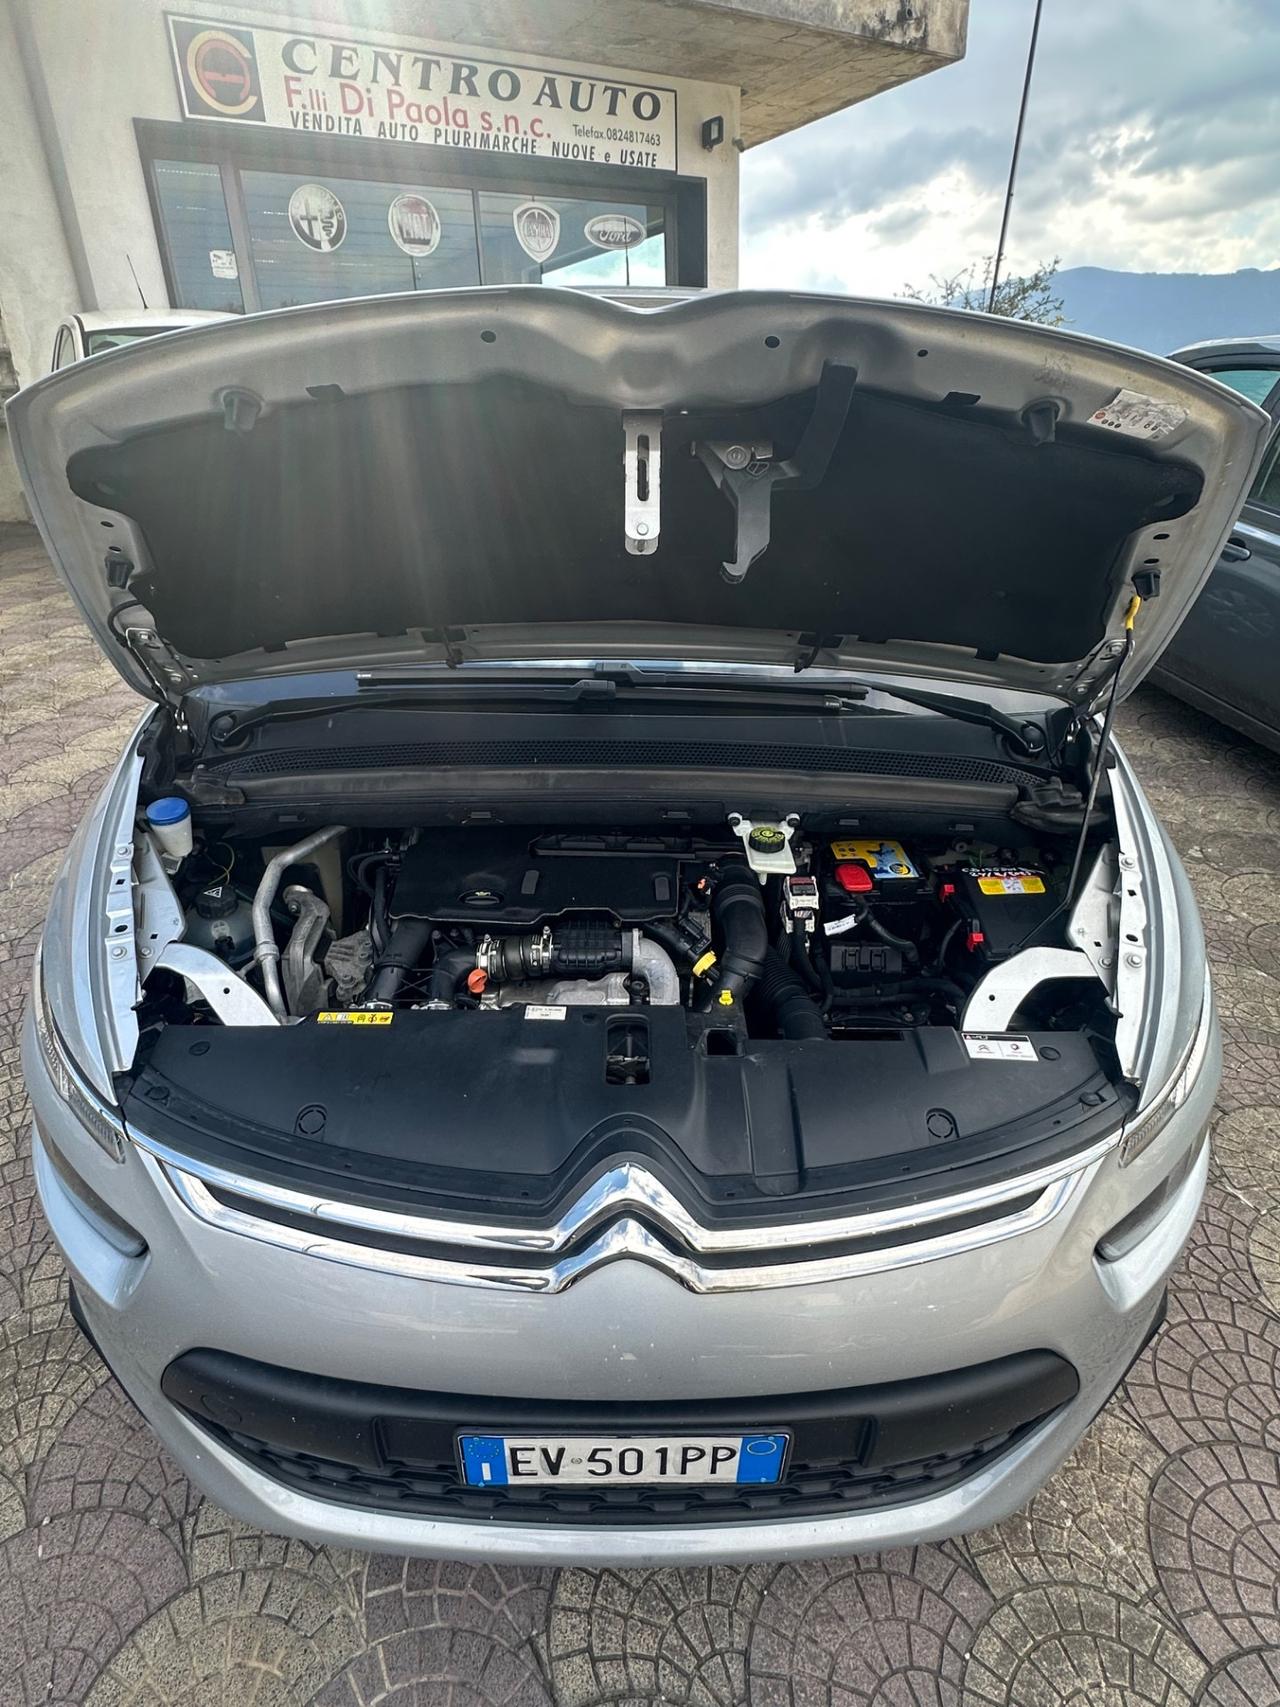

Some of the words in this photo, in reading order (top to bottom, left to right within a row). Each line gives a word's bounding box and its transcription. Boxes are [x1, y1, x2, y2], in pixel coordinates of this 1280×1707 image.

[281, 39, 521, 102] CENTRO
[532, 76, 661, 121] AUTO
[284, 75, 328, 112] F.lli
[339, 82, 375, 117] Di
[386, 88, 469, 129] Paola
[481, 111, 551, 139] s.n.c.
[289, 110, 362, 135] VENDITA
[378, 121, 419, 141] AUTO
[434, 128, 537, 154] PLURIMARCHE
[552, 141, 595, 161] NUOVE
[604, 152, 611, 163] e
[620, 149, 657, 167] USATE
[509, 1446, 566, 1476] EV
[587, 1446, 738, 1476] 501PP
